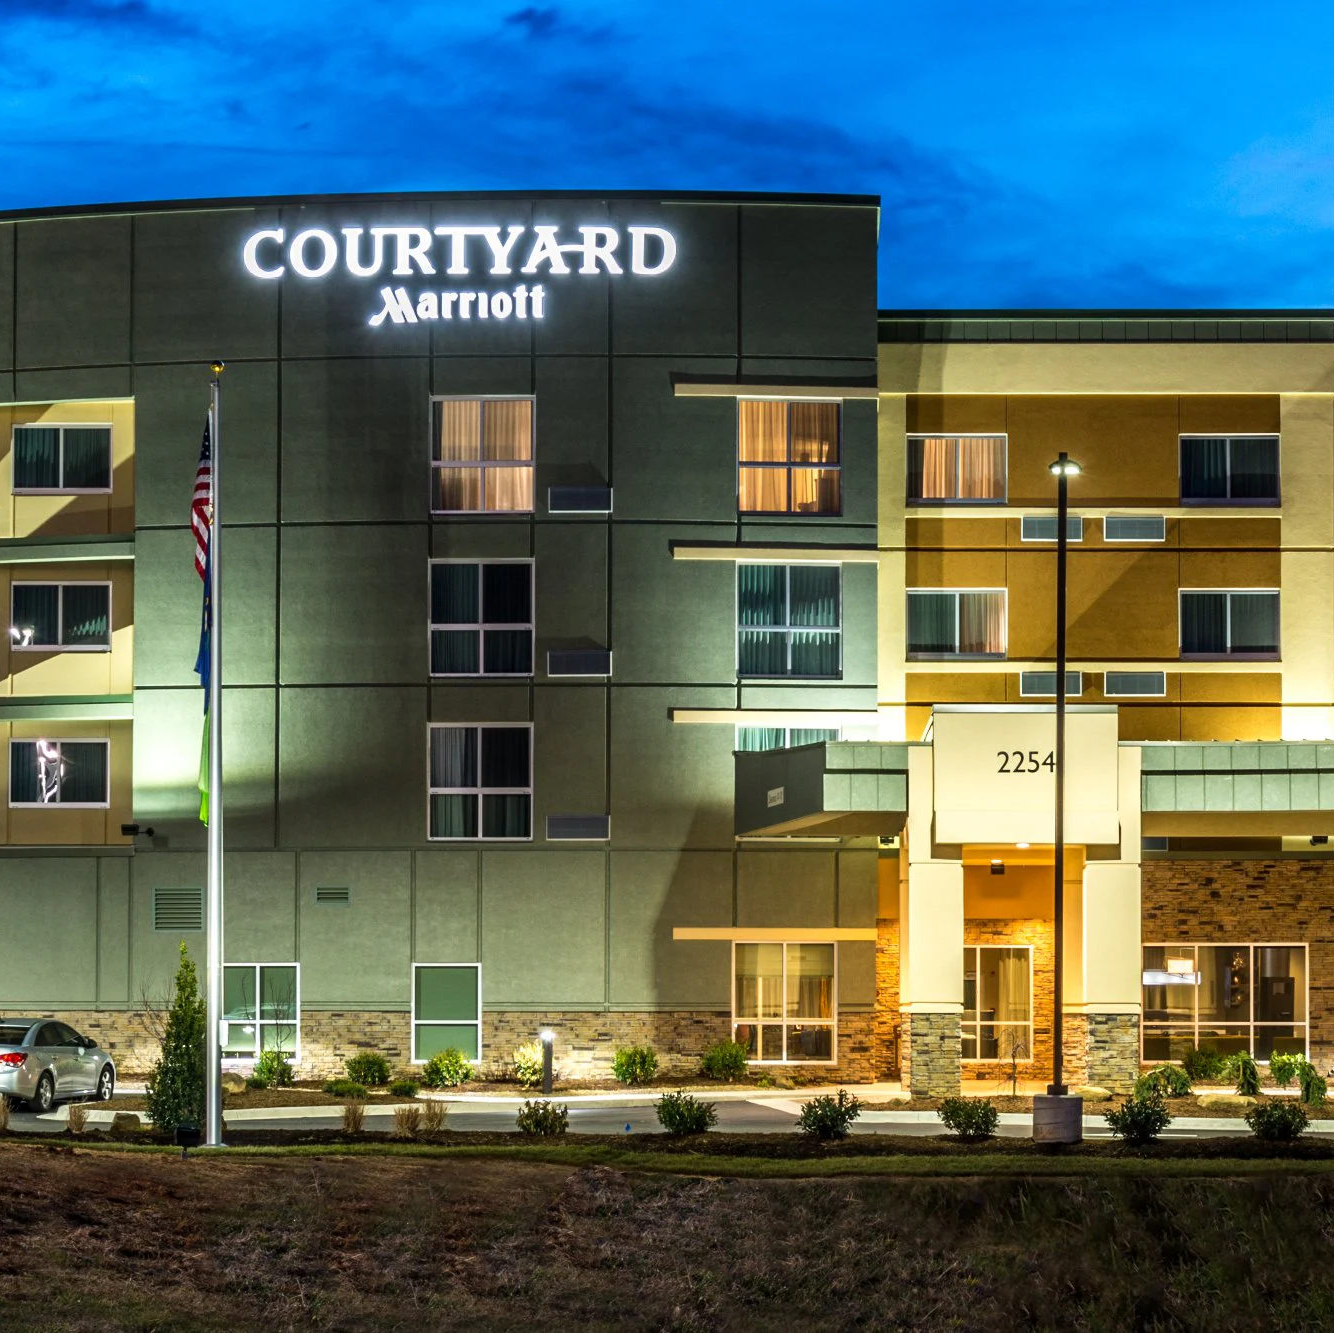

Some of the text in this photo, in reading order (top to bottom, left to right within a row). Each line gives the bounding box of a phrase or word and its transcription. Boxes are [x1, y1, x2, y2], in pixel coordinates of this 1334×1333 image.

[243, 225, 677, 279] COURTYARD
[368, 284, 546, 327] Marriott
[996, 750, 1057, 774] 2254
